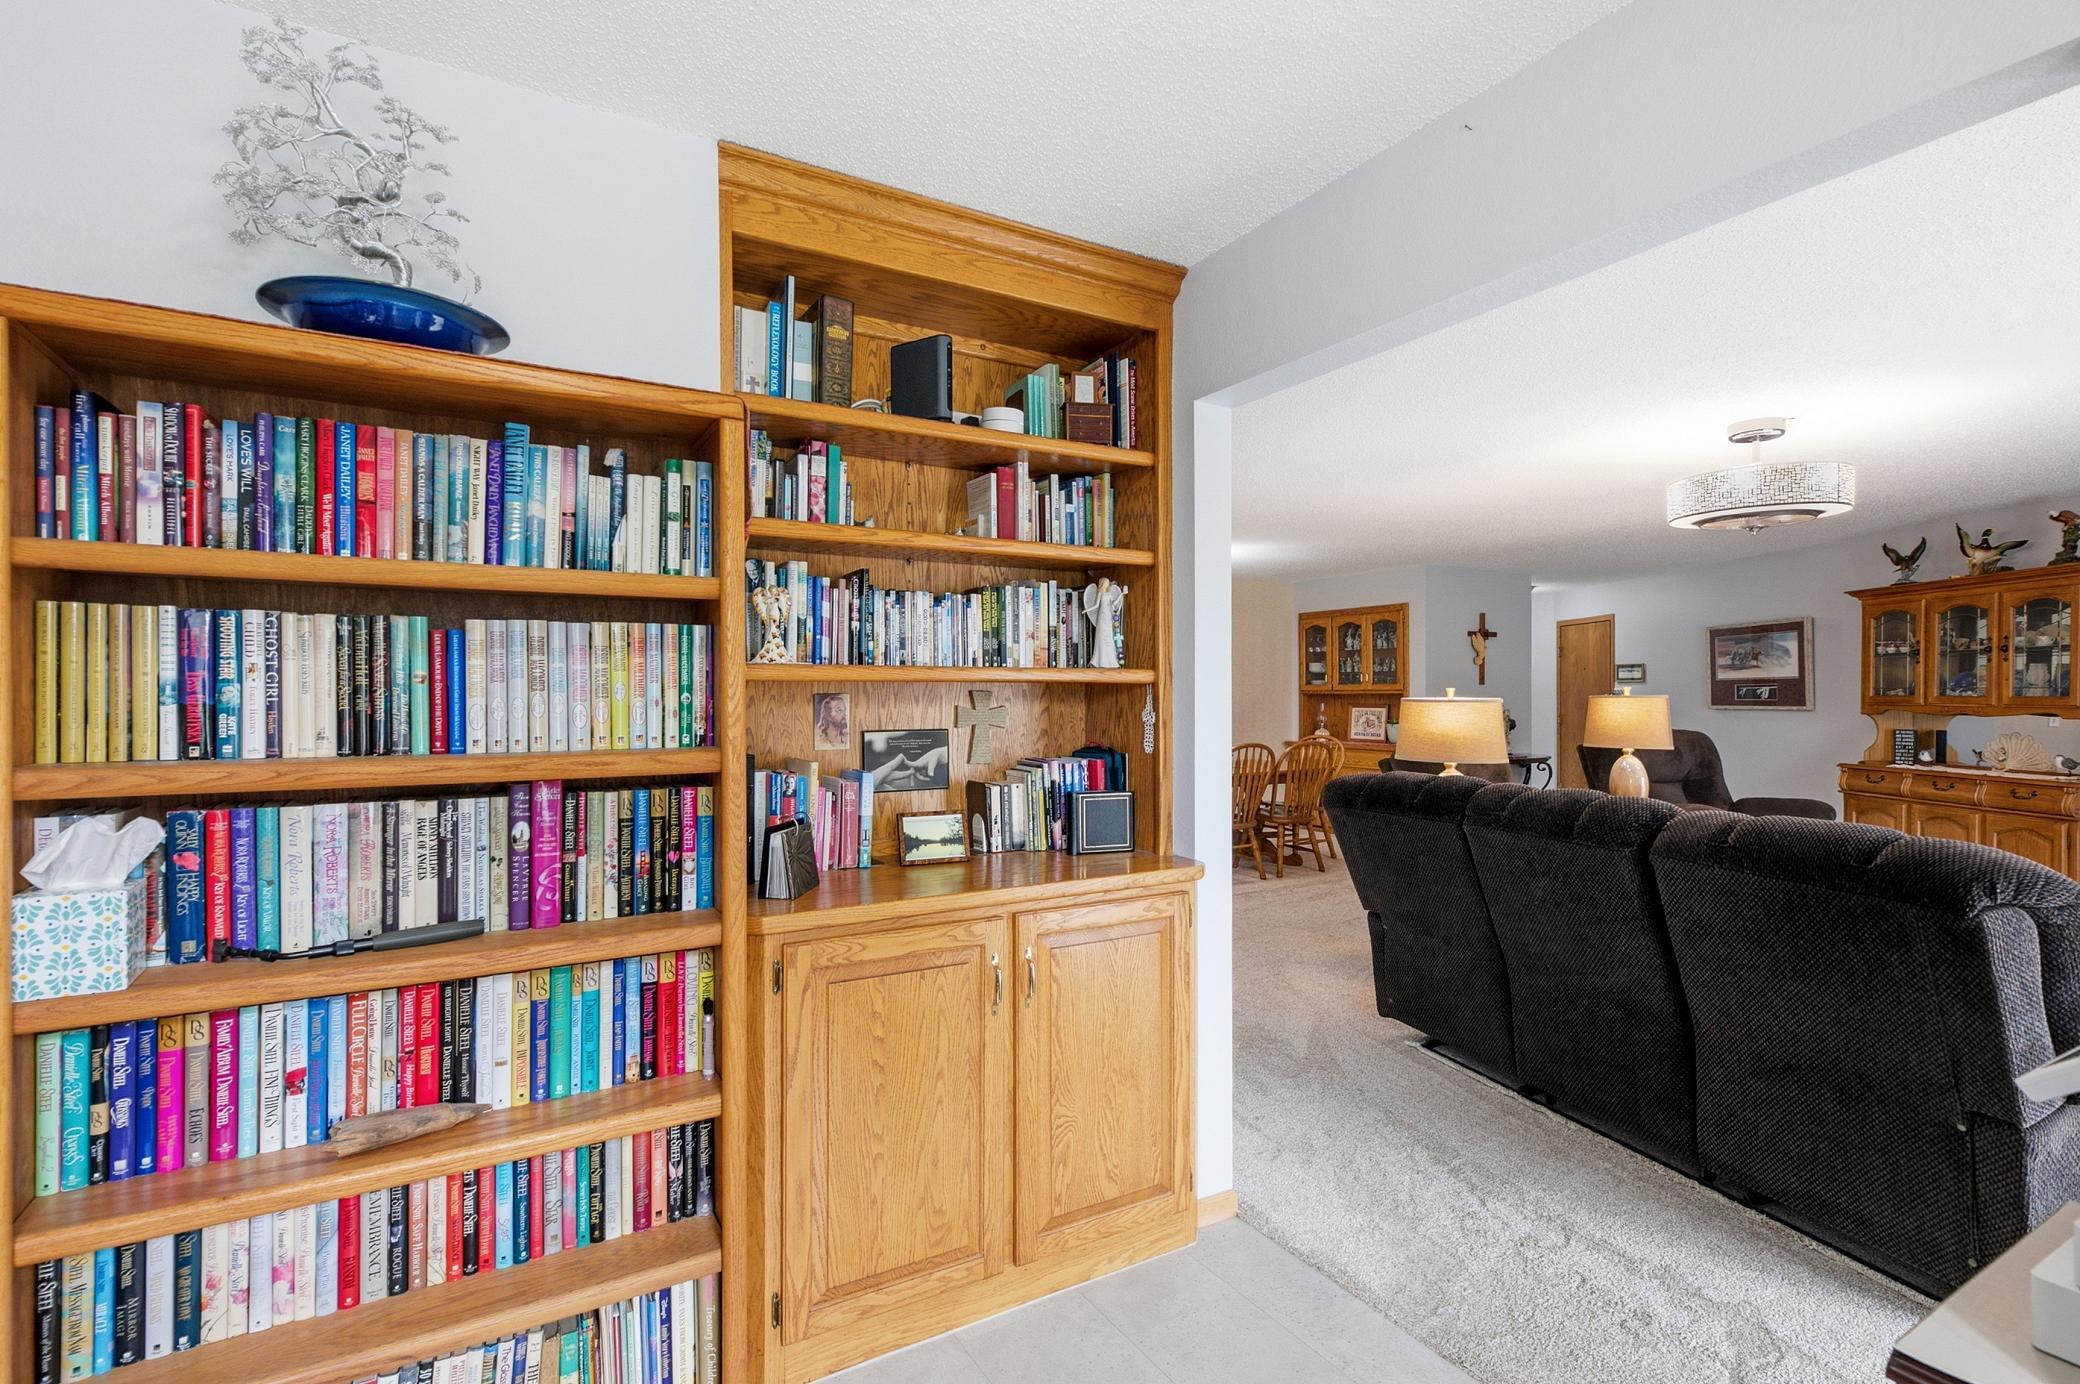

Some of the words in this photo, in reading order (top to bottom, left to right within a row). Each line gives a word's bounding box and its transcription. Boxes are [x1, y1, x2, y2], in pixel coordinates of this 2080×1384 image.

[770, 313, 781, 367] REFLEXOLOGY
[770, 369, 781, 392] BOOK
[74, 423, 87, 439] call
[299, 420, 310, 441] MARY
[340, 425, 351, 461] JANET
[504, 428, 525, 457] JANET
[240, 429, 252, 465] LOVE'S
[299, 442, 310, 474] HIGGINS
[417, 437, 426, 466] STANDS
[472, 445, 481, 466] NIGHT
[101, 475, 111, 498] Mitch
[240, 468, 252, 493] WILL
[340, 461, 351, 499] DAILEY
[417, 474, 426, 502] CALDER
[472, 468, 481, 481] WAY
[299, 475, 310, 502] CLARK
[471, 483, 481, 499] Janet
[101, 500, 111, 525] Albom
[417, 503, 426, 520] MAN
[471, 500, 481, 521] Dailey
[218, 616, 236, 657] SHOOTING
[244, 621, 255, 658] CHILD
[265, 616, 280, 668] GHOST
[434, 633, 442, 653] LOUIS
[218, 658, 236, 680] STAR
[265, 671, 280, 706] GIRL
[218, 713, 228, 738] GREEN
[229, 715, 237, 736] KATE
[248, 708, 257, 736] HAYDEN
[565, 800, 576, 831] DANIELLE
[682, 790, 695, 826] DANIELLE
[175, 819, 188, 850] QUINN
[187, 828, 199, 849] SALLY
[287, 815, 301, 847] Nora
[325, 813, 341, 844] NORA
[385, 814, 396, 846] Stranger
[416, 818, 427, 839] RAGE
[429, 816, 438, 841] SIDNEY
[565, 830, 576, 850] STEEL
[682, 827, 695, 850] STEEL
[235, 837, 248, 856] NORA
[416, 840, 427, 851] OF
[235, 856, 248, 883] ROBERTS
[323, 845, 343, 895] ROBERTS
[359, 839, 376, 882] ROBERTS
[416, 851, 427, 881] ANGELS
[429, 842, 438, 879] SHELDON
[187, 872, 200, 902] HAPPY
[284, 853, 304, 897] Roberts
[385, 867, 396, 893] Mirror
[511, 855, 521, 903] SPENCER
[175, 872, 188, 916] ENDINGS
[236, 893, 247, 908] KEY
[262, 900, 272, 910] OF
[236, 908, 247, 918] OF
[236, 918, 247, 941] LIGHT
[444, 986, 452, 998] HIS
[349, 1000, 367, 1026] FULL
[368, 999, 379, 1020] Going
[403, 991, 416, 1024] DANIELLE
[444, 998, 452, 1022] BRIGHT
[459, 986, 473, 1026] DANIELLE
[368, 1020, 379, 1041] Home
[403, 1024, 416, 1046] STEEL
[444, 1022, 452, 1043] LIGHT
[459, 1027, 473, 1052] STEEL
[349, 1026, 367, 1066] CIRCLE
[39, 1041, 56, 1085] DANIELLE
[441, 1045, 453, 1080] DANIELLE
[264, 1069, 282, 1093] FINE
[441, 1080, 453, 1102] STEEL
[39, 1086, 56, 1114] STEEL
[264, 1094, 282, 1129] THINGS
[189, 1107, 205, 1144] ECHOES
[670, 1141, 683, 1164] STEEL
[517, 1173, 530, 1199] STEEL
[544, 1166, 563, 1195] STEEL
[391, 1201, 404, 1223] STEEL
[544, 1199, 563, 1227] STAR
[412, 1223, 423, 1242] SAFE
[392, 1247, 403, 1280] ROGUE
[412, 1243, 423, 1276] HARBOUR
[39, 1281, 57, 1313] STEEL
[115, 1305, 127, 1338] IMAGE
[126, 1296, 140, 1340] MIRROR
[705, 1304, 717, 1341] Treasury
[500, 1346, 512, 1362] The
[705, 1343, 717, 1351] of
[705, 1353, 717, 1384] Childre
